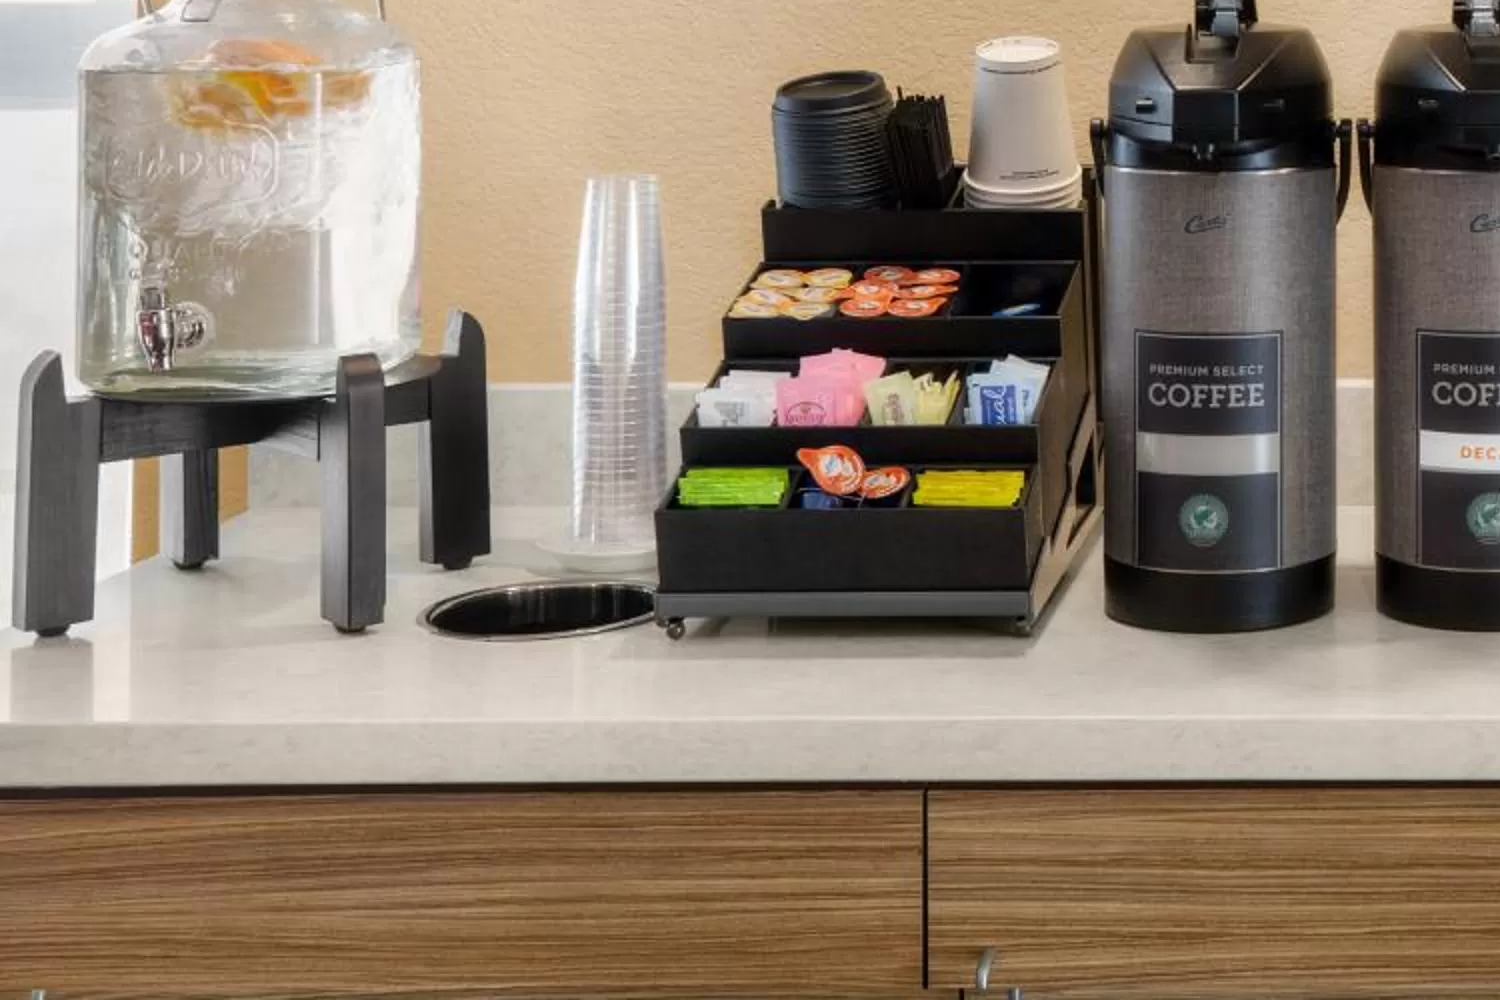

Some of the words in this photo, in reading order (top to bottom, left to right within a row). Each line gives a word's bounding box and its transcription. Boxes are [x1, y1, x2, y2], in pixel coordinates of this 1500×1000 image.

[1149, 363, 1209, 377] PREMIUM
[1212, 364, 1264, 377] SELECT
[1432, 362, 1496, 375] PREMIUM
[1148, 382, 1265, 408] COFFEE
